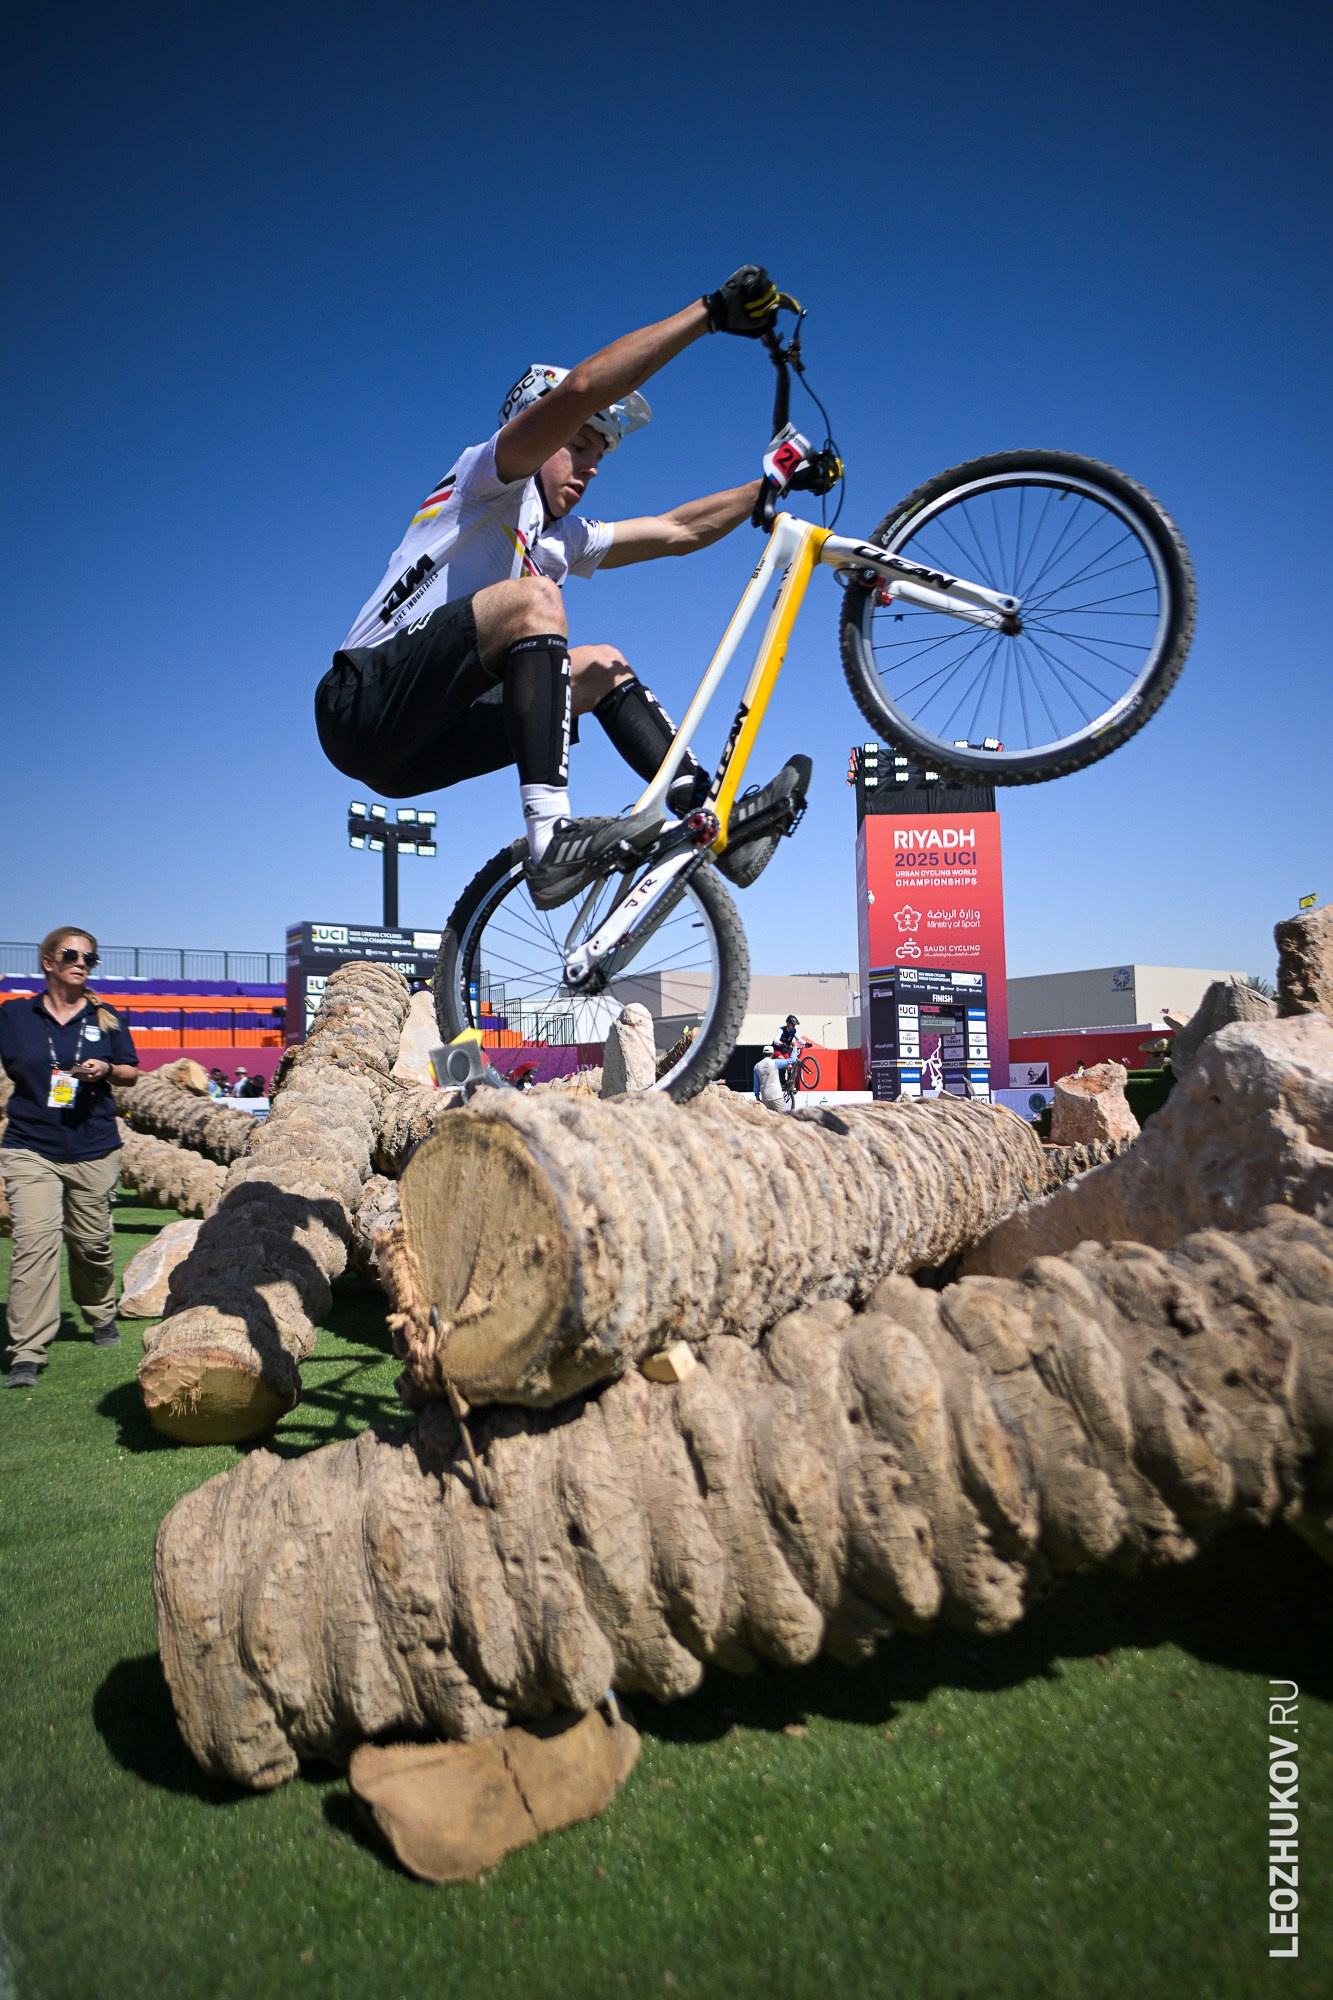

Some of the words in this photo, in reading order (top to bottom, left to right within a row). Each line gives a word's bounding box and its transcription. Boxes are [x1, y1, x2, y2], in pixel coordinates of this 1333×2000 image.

[502, 375, 536, 419] POC
[852, 545, 958, 590] CLEAN
[379, 553, 436, 625] KTM
[393, 609, 407, 627] BIKE
[406, 571, 439, 610] INDUSTRIES
[893, 828, 976, 849] RIYADH
[894, 852, 940, 867] 2025
[943, 851, 977, 866] UCI
[920, 869, 951, 877] CYCLING
[951, 868, 977, 876] WORLD
[895, 877, 977, 887] CHAMPIONSHIPS
[926, 908, 957, 920] الرياضة
[959, 908, 981, 920] وزارة
[927, 920, 953, 930] Ministry
[952, 920, 961, 928] of
[961, 919, 981, 929] Sport
[319, 929, 344, 941] UCI
[902, 971, 917, 980] UCI
[932, 993, 953, 1003] FINISH
[902, 1006, 916, 1015] UCI
